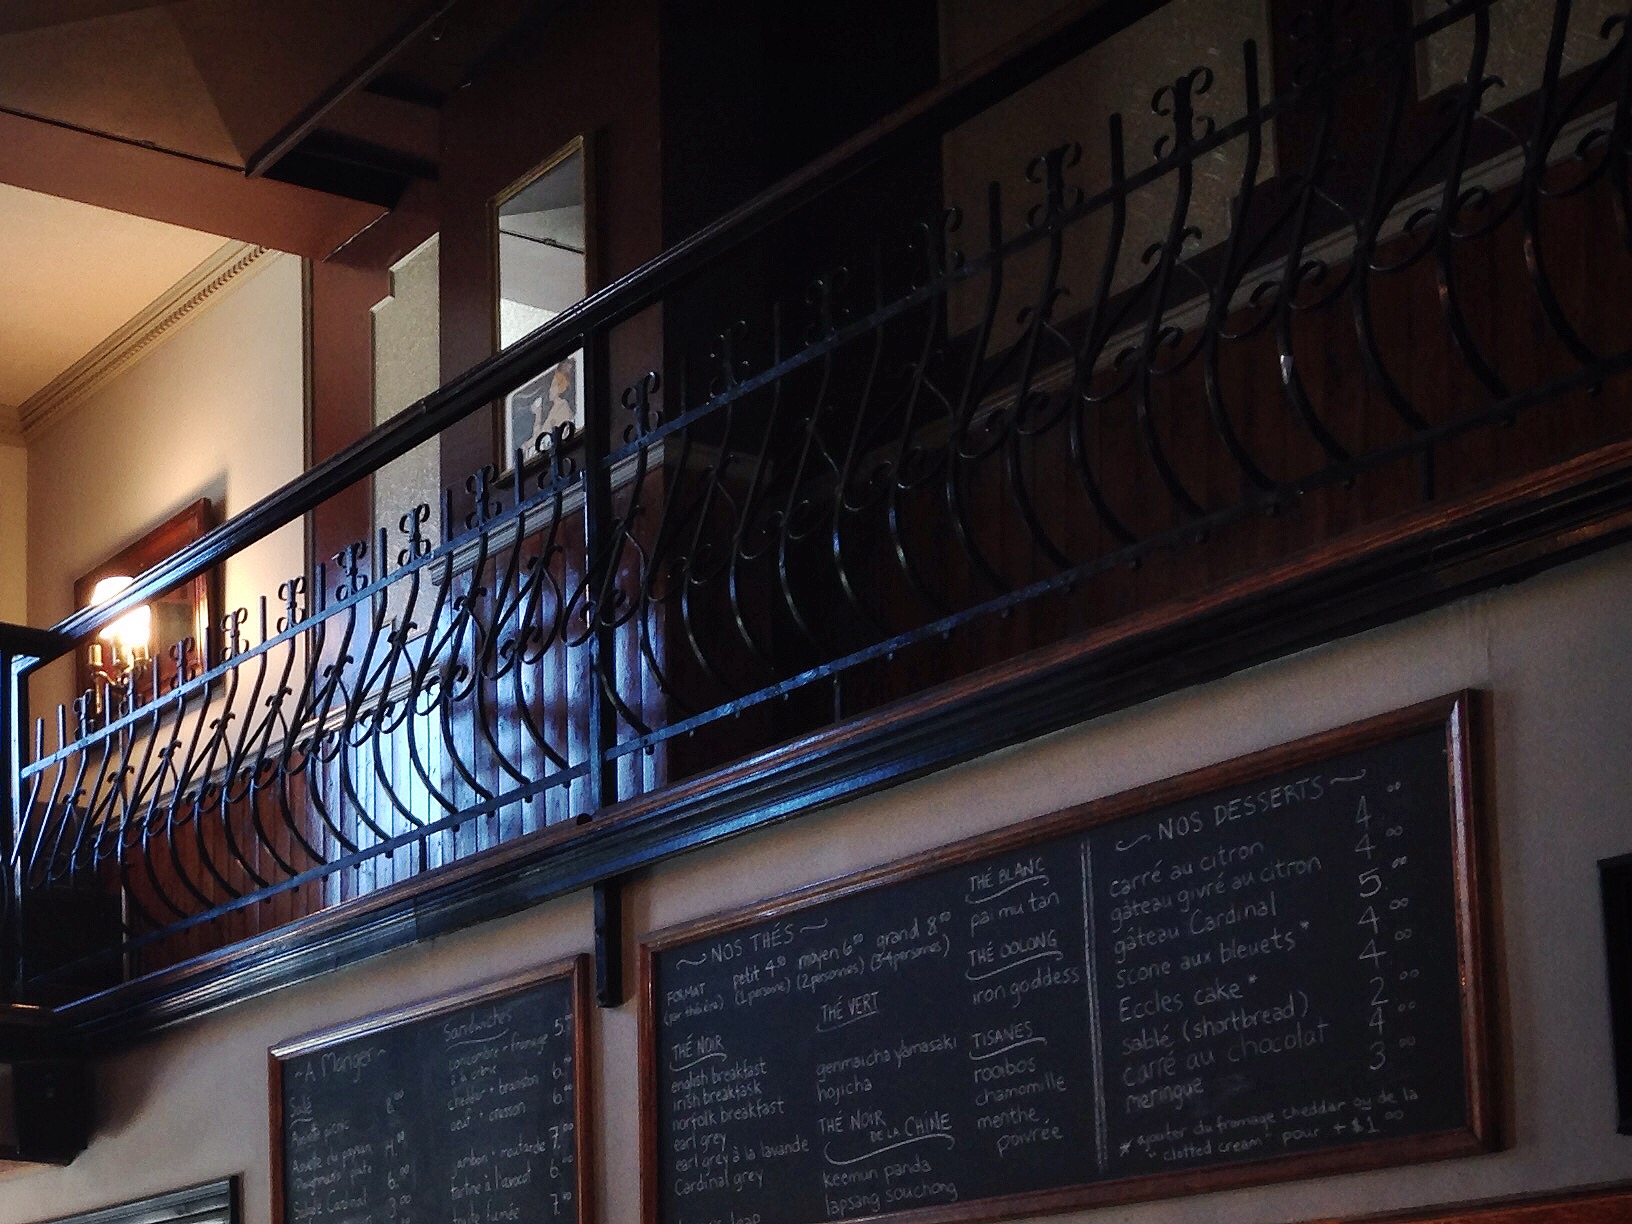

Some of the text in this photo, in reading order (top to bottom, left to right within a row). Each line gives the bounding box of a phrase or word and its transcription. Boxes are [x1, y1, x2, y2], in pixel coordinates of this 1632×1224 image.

[1158, 776, 1324, 840] NOS DESSERTS
[970, 857, 1046, 892] THÉ BLANC
[1109, 860, 1163, 898] carré
[1170, 863, 1193, 880] au
[1200, 841, 1264, 871] citron
[998, 904, 1024, 919] mu
[1028, 891, 1060, 912] tan
[1111, 895, 1173, 934] gâteau
[1177, 872, 1226, 913] givré
[1232, 872, 1255, 890] au
[1260, 856, 1322, 882] citron
[711, 922, 794, 962] NOS THÉS
[1114, 926, 1180, 964] gâteau
[1190, 891, 1277, 935] Cardinal
[733, 965, 760, 990] petit
[798, 947, 839, 970] moyen
[876, 918, 919, 949] grand
[968, 929, 1057, 967] THÉ OOLONG
[973, 965, 1080, 1008] iron goddess
[1116, 961, 1171, 989] scone
[1180, 951, 1211, 970] aux
[820, 991, 879, 1022] THÉ VERT
[1119, 989, 1184, 1023] Eccles
[1193, 978, 1244, 1006] cake
[972, 1020, 1033, 1049] TISANES
[1122, 1024, 1175, 1056] sablé
[1182, 990, 1308, 1042] (shortbread)
[697, 1034, 725, 1054] NOIR
[816, 1034, 957, 1082] genmaicha yamasaki
[1122, 1050, 1176, 1087] carré
[1186, 1051, 1216, 1070] au
[1227, 1021, 1329, 1063] chocolat
[712, 1057, 767, 1085] breakfast
[974, 1056, 1036, 1084] rooibos
[673, 1094, 701, 1112] irish
[817, 1074, 873, 1105] hojicha
[1126, 1077, 1204, 1114] meringue
[673, 1096, 784, 1131] norfolk breakfast
[818, 1109, 887, 1135] THÉ NOIR
[977, 1107, 1040, 1129] menthe
[1193, 1120, 1213, 1136] du
[1282, 1099, 1346, 1121] cheddar
[1377, 1089, 1397, 1104] de
[1402, 1087, 1419, 1101] la
[674, 1133, 726, 1153] earl grey
[1281, 1127, 1320, 1147] pour
[675, 1153, 698, 1172] earl
[702, 1153, 729, 1176] grey
[823, 1154, 932, 1188] keemun panda
[675, 1169, 764, 1196] Cardinal grey
[825, 1181, 958, 1216] lapsang souchong
